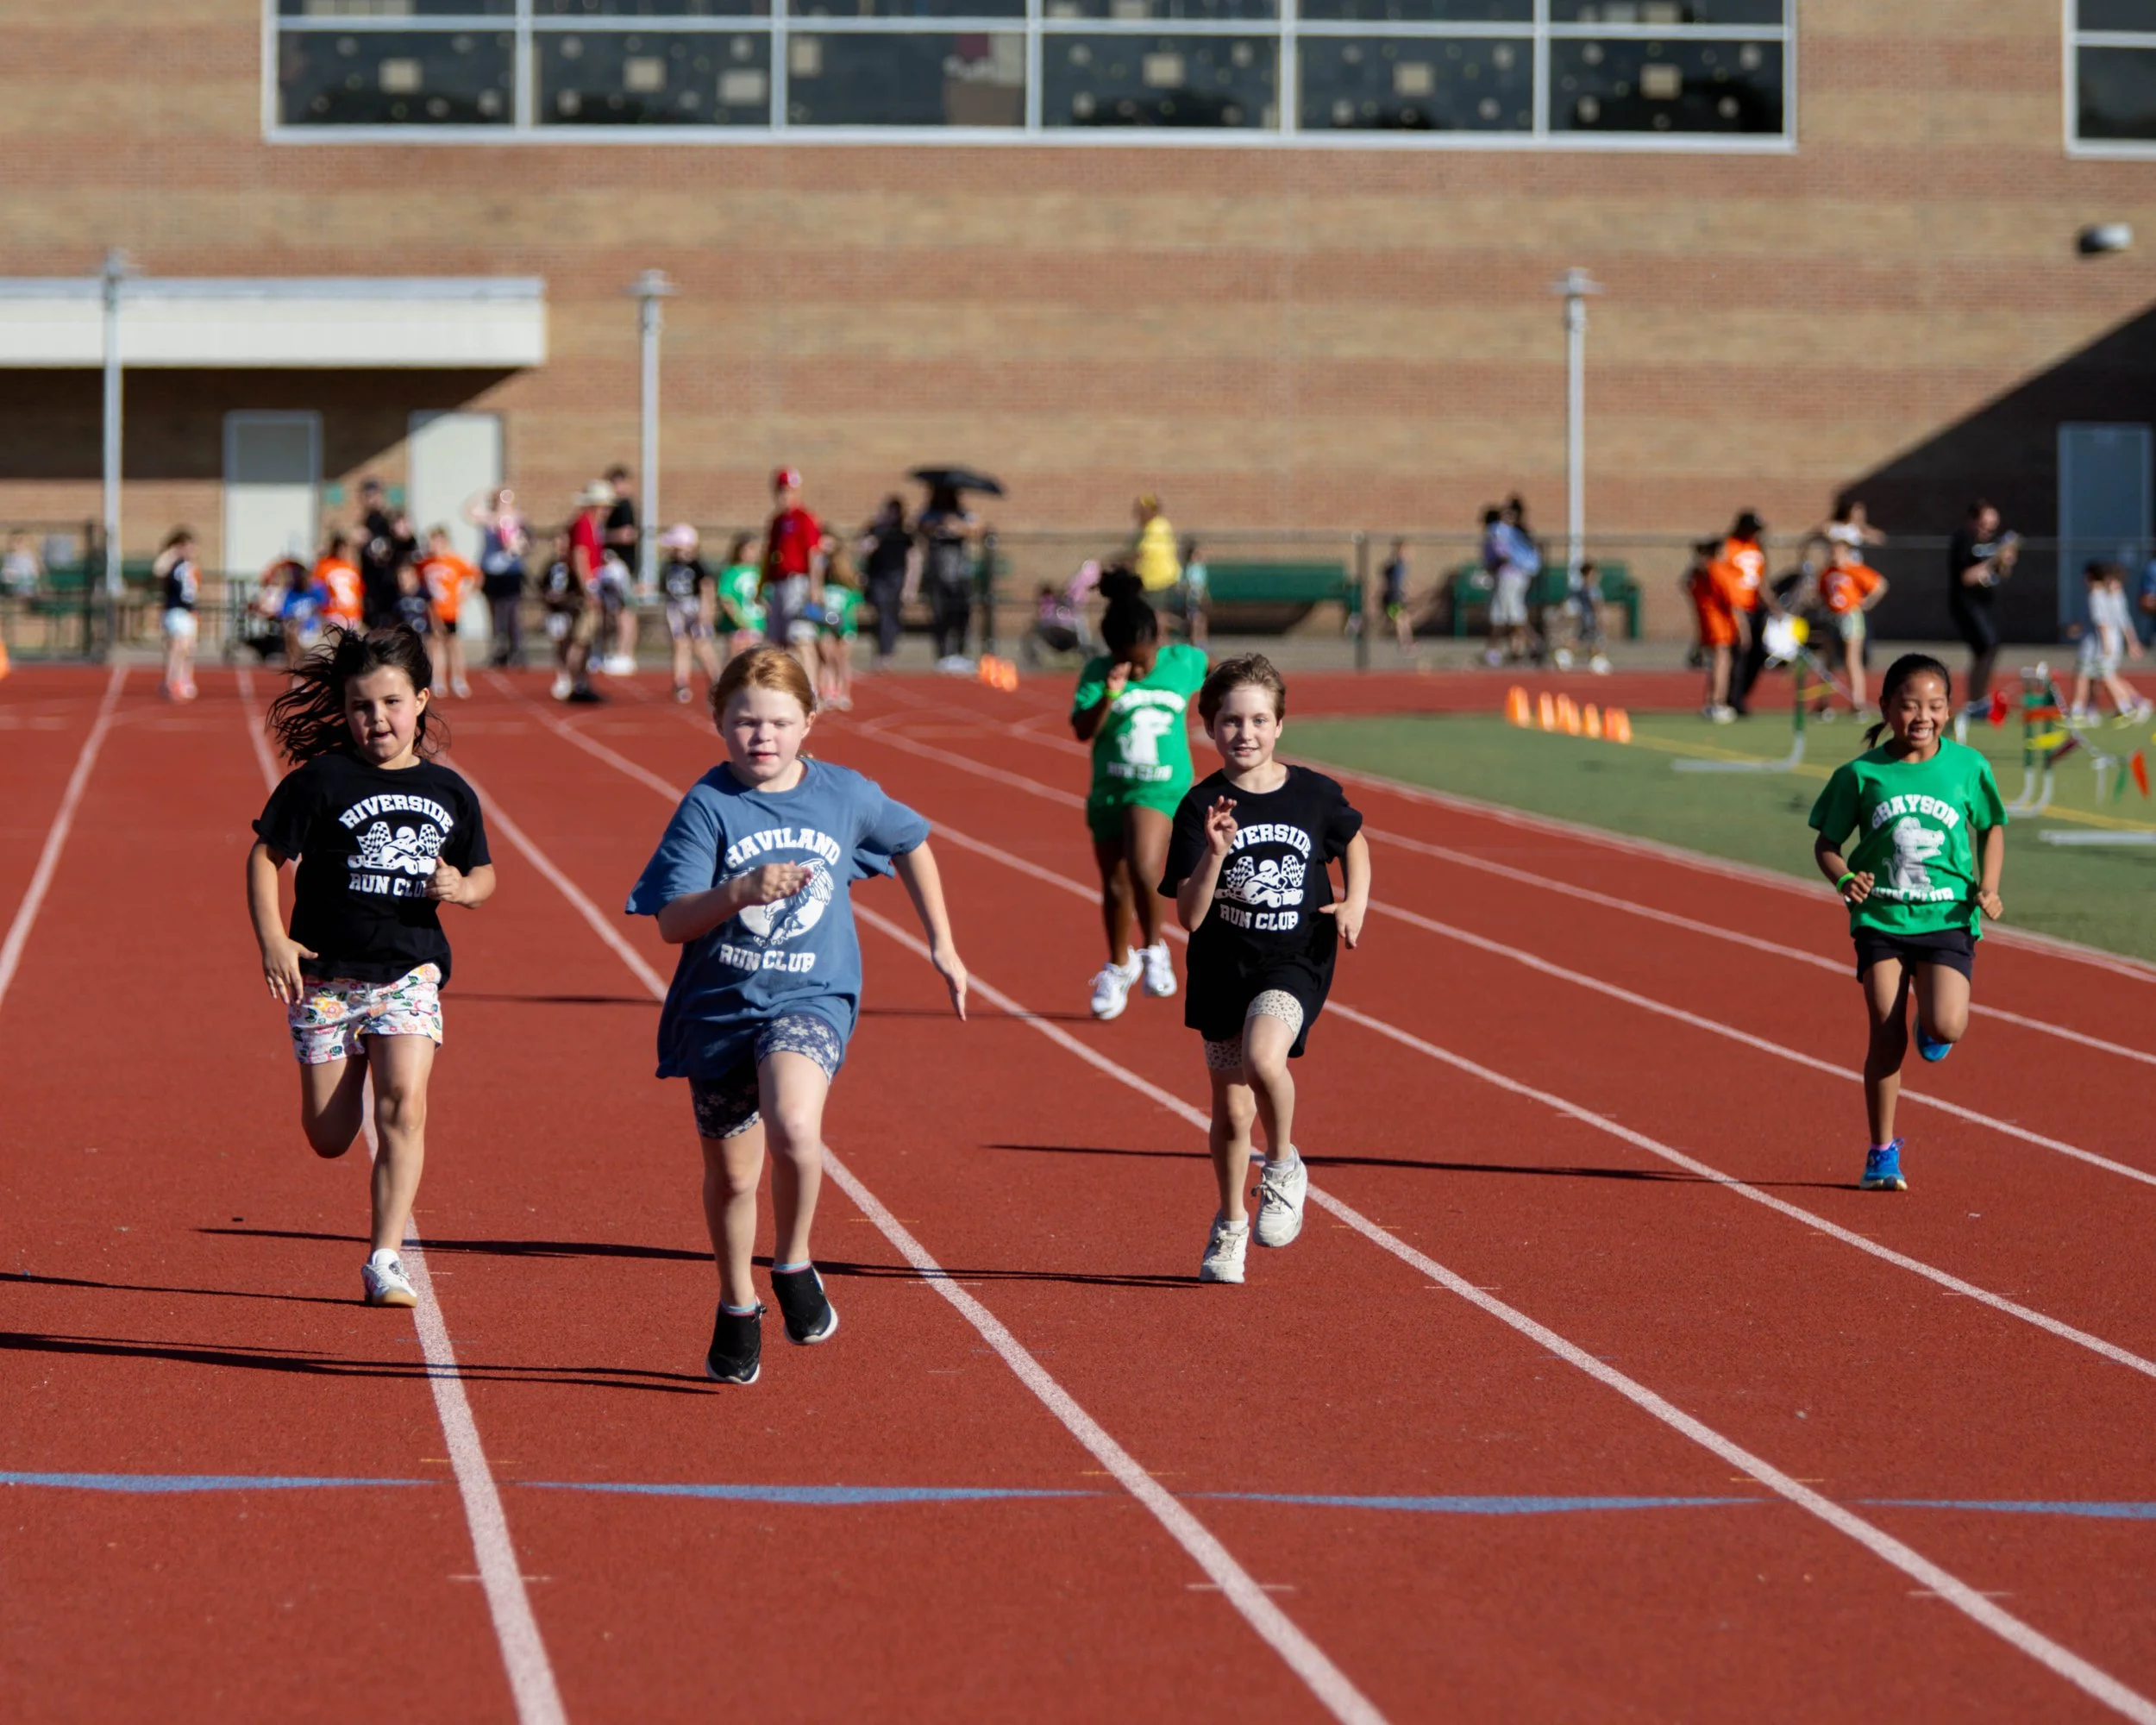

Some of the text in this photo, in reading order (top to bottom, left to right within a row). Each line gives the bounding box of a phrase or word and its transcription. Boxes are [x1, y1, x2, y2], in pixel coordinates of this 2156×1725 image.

[338, 794, 454, 834] RIVERSIDE
[1871, 794, 1960, 830] GRAYSON
[724, 827, 841, 869] HAVILAND
[1228, 823, 1312, 860] VERSIDE
[348, 872, 391, 896] RUN
[1219, 903, 1299, 932] RUN CLUB
[718, 944, 816, 973] RUN CLUB
